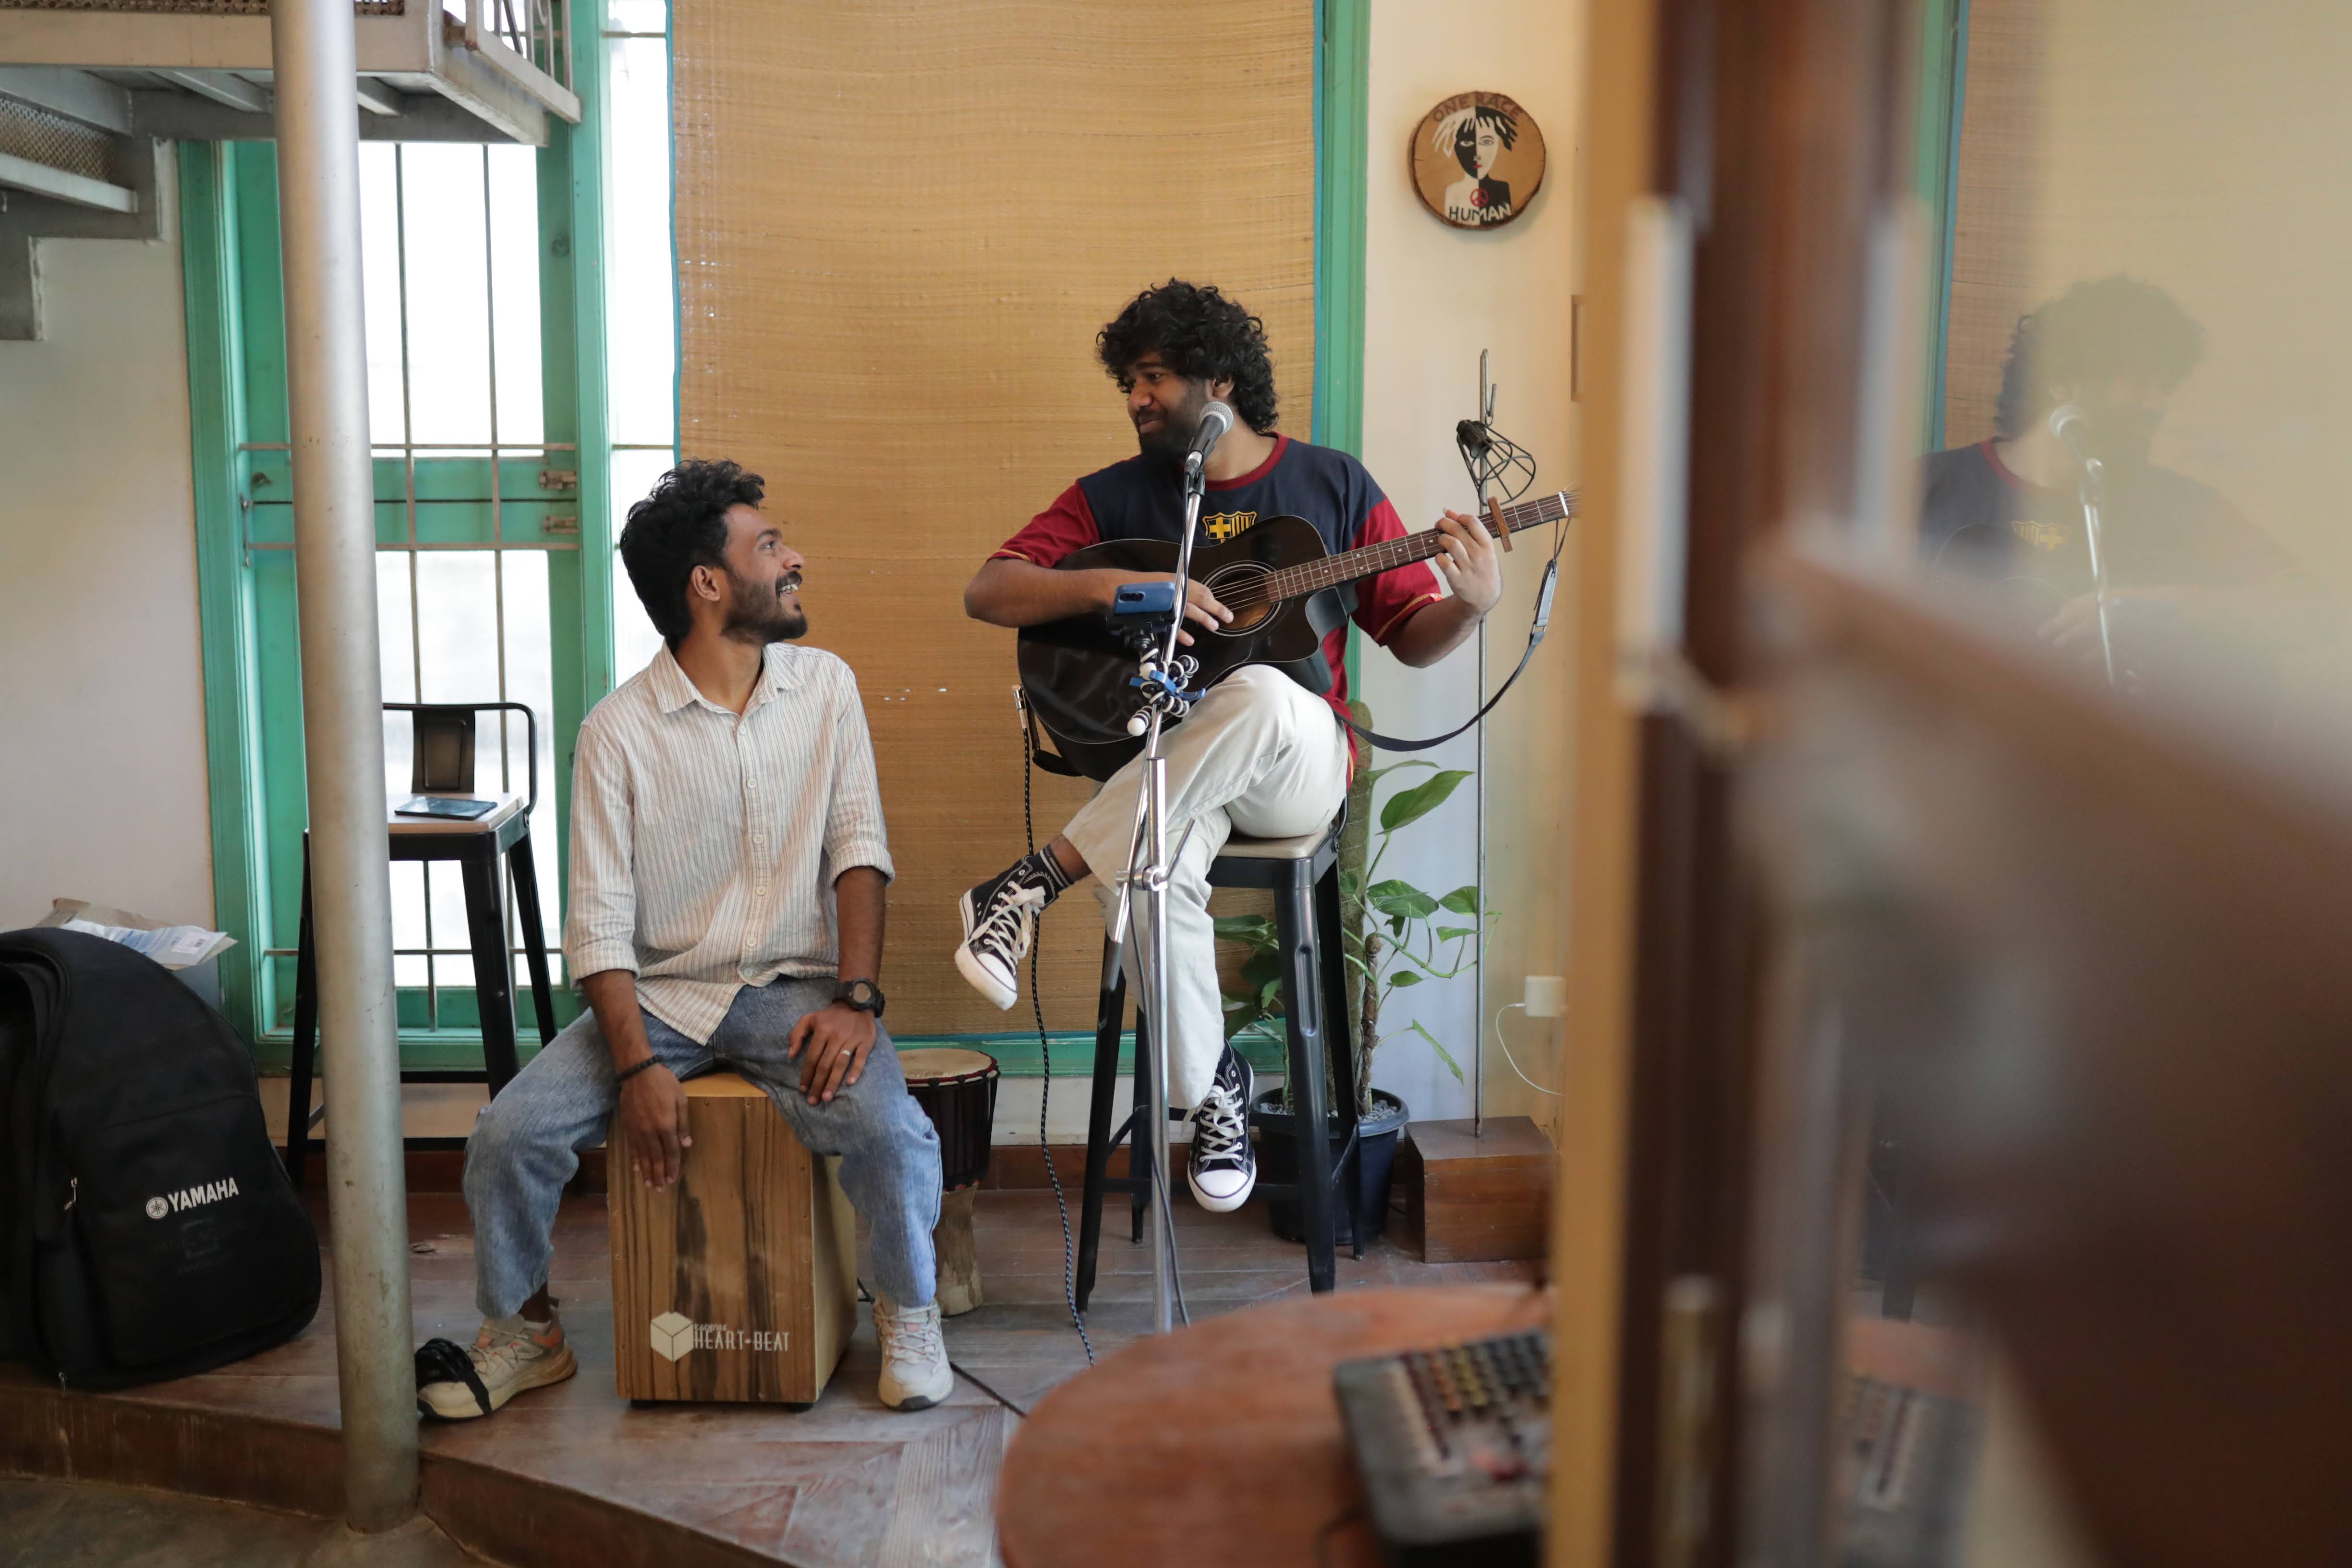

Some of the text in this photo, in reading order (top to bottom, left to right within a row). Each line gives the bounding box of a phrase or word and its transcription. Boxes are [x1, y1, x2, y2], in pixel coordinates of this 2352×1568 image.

[1433, 93, 1523, 122] ONE RACE
[1449, 203, 1513, 221] HUMAN
[168, 1178, 239, 1212] YAMAHA
